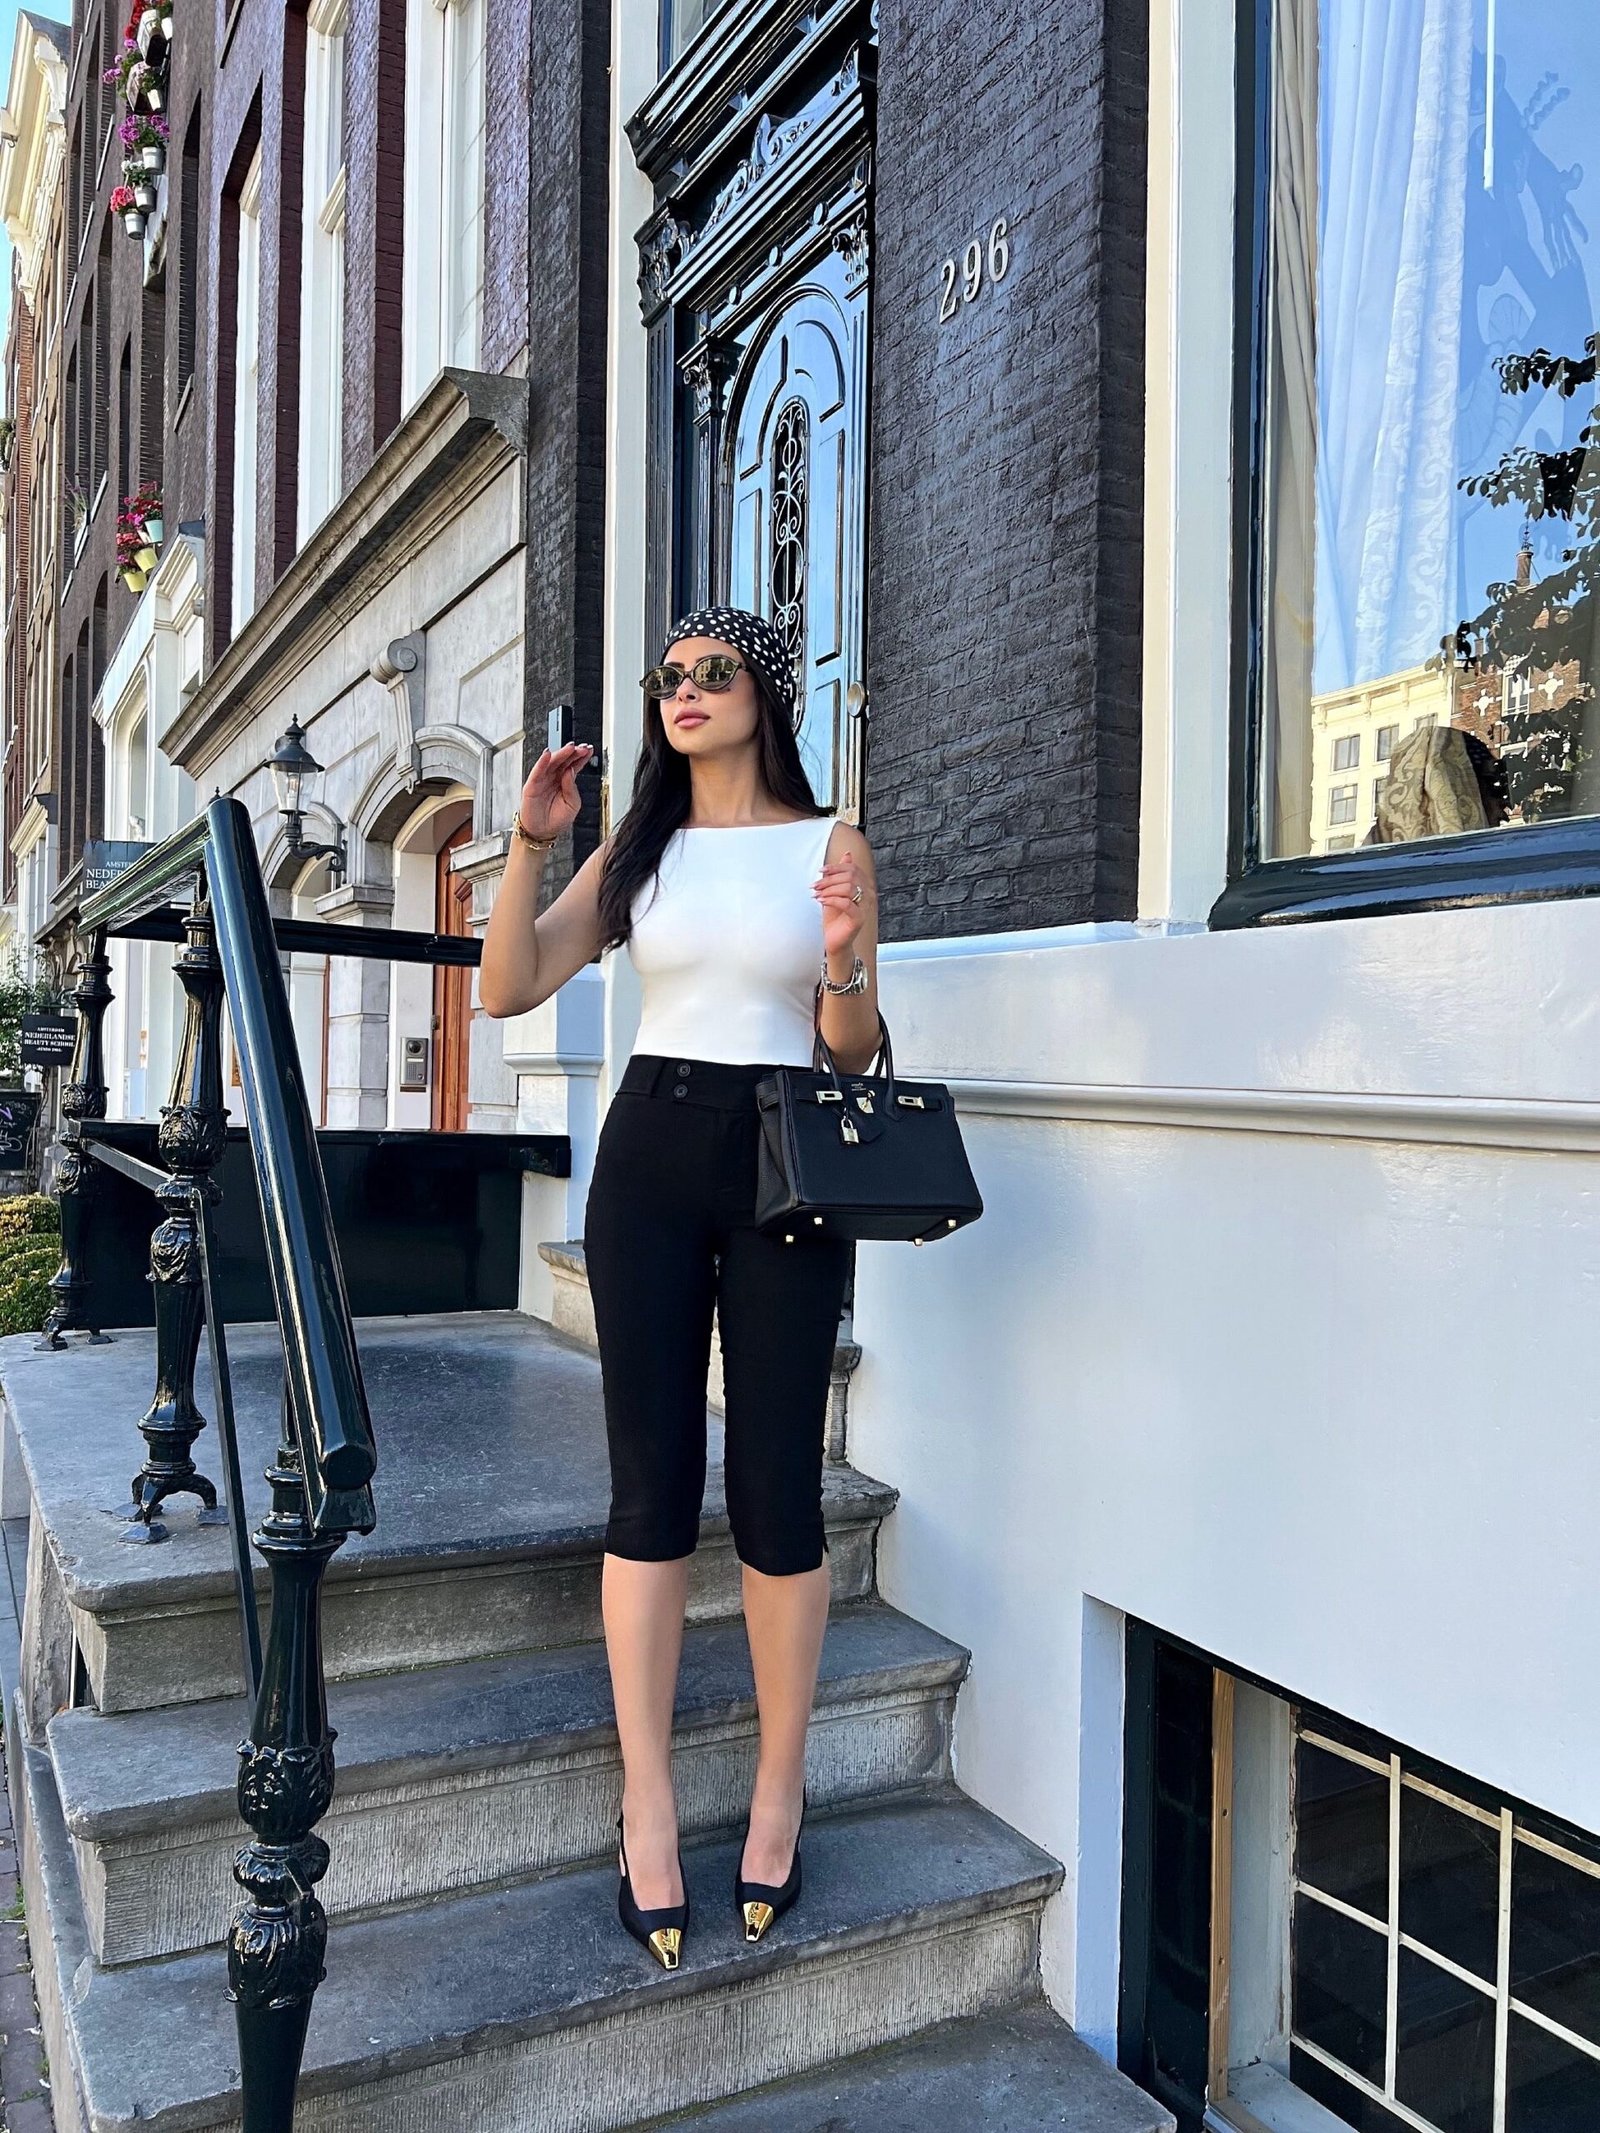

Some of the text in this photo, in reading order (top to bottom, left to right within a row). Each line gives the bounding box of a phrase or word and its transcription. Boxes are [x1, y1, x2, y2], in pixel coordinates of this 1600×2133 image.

[940, 216, 1009, 324] 296
[24, 1032, 76, 1041] NEDERLANDSE
[24, 1039, 76, 1048] BEAUTY SCHOOL
